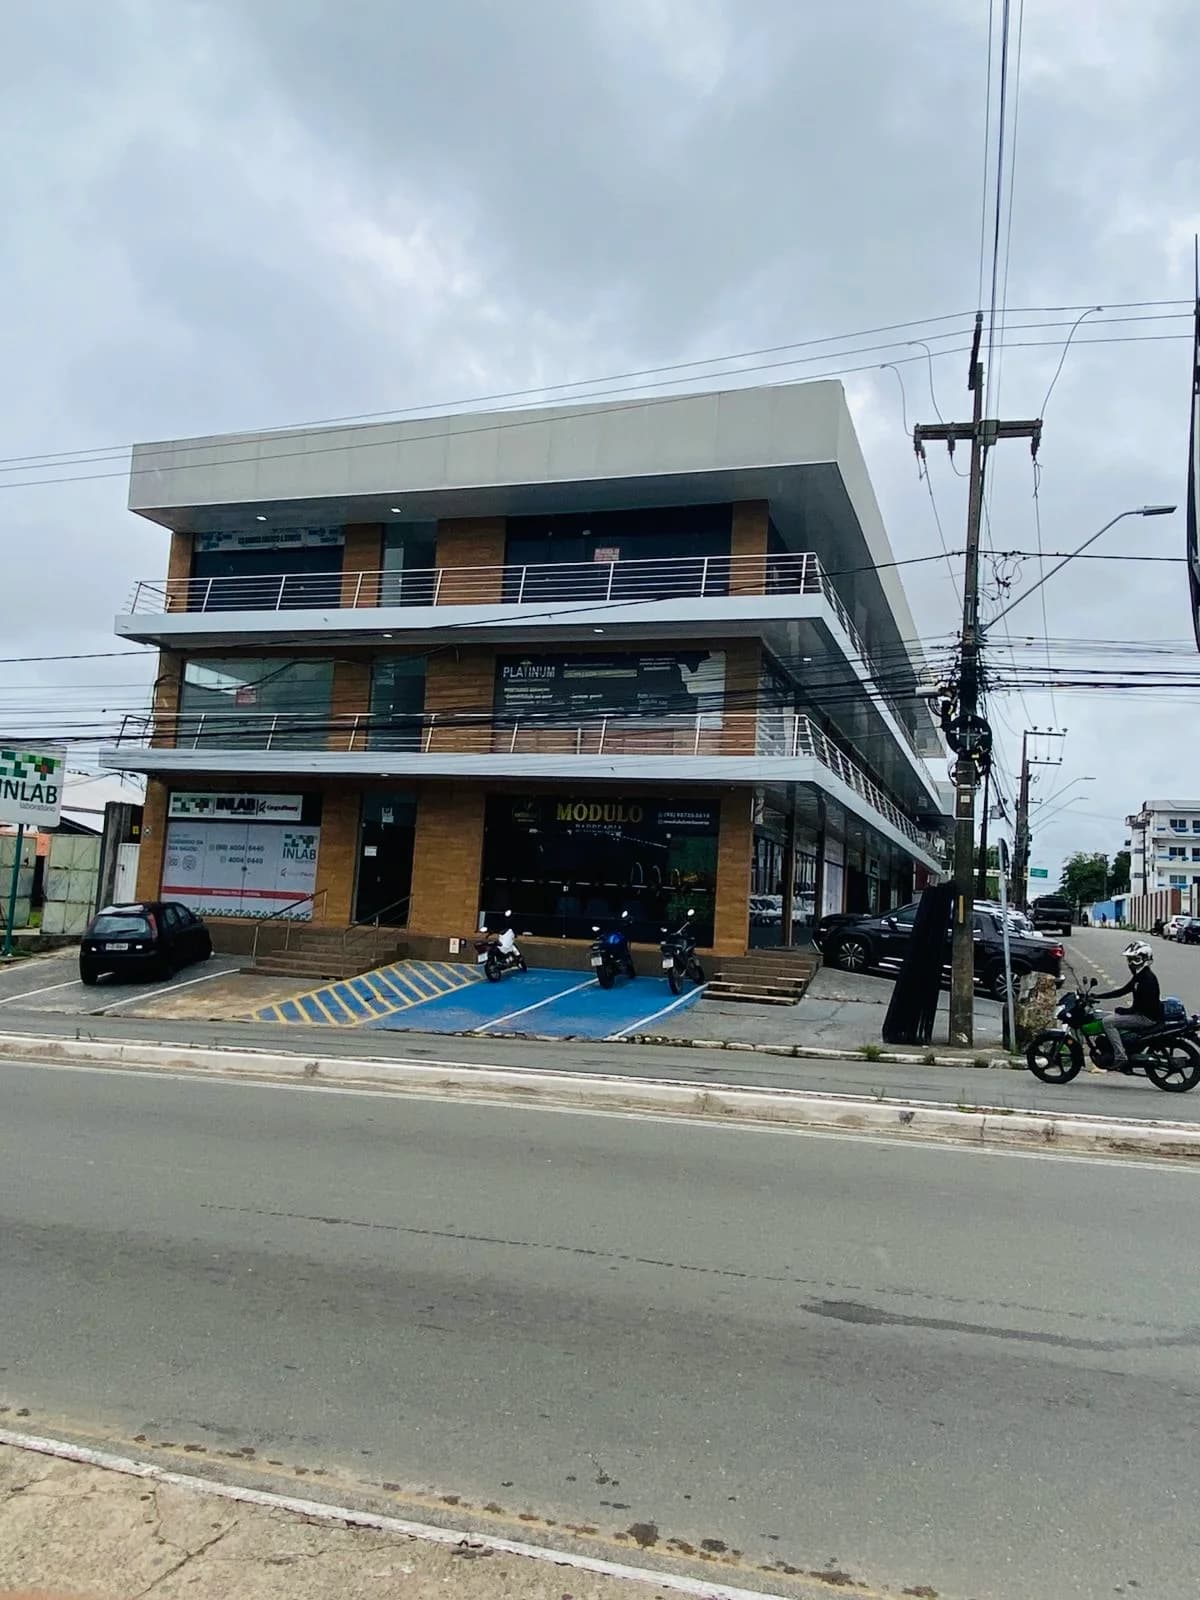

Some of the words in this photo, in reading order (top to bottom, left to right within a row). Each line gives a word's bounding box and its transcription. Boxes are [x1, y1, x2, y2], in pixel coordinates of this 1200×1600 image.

[503, 666, 555, 678] PLATINUM
[216, 797, 256, 810] INLAB
[557, 800, 643, 822] MÓDULO
[283, 848, 316, 860] INLAB
